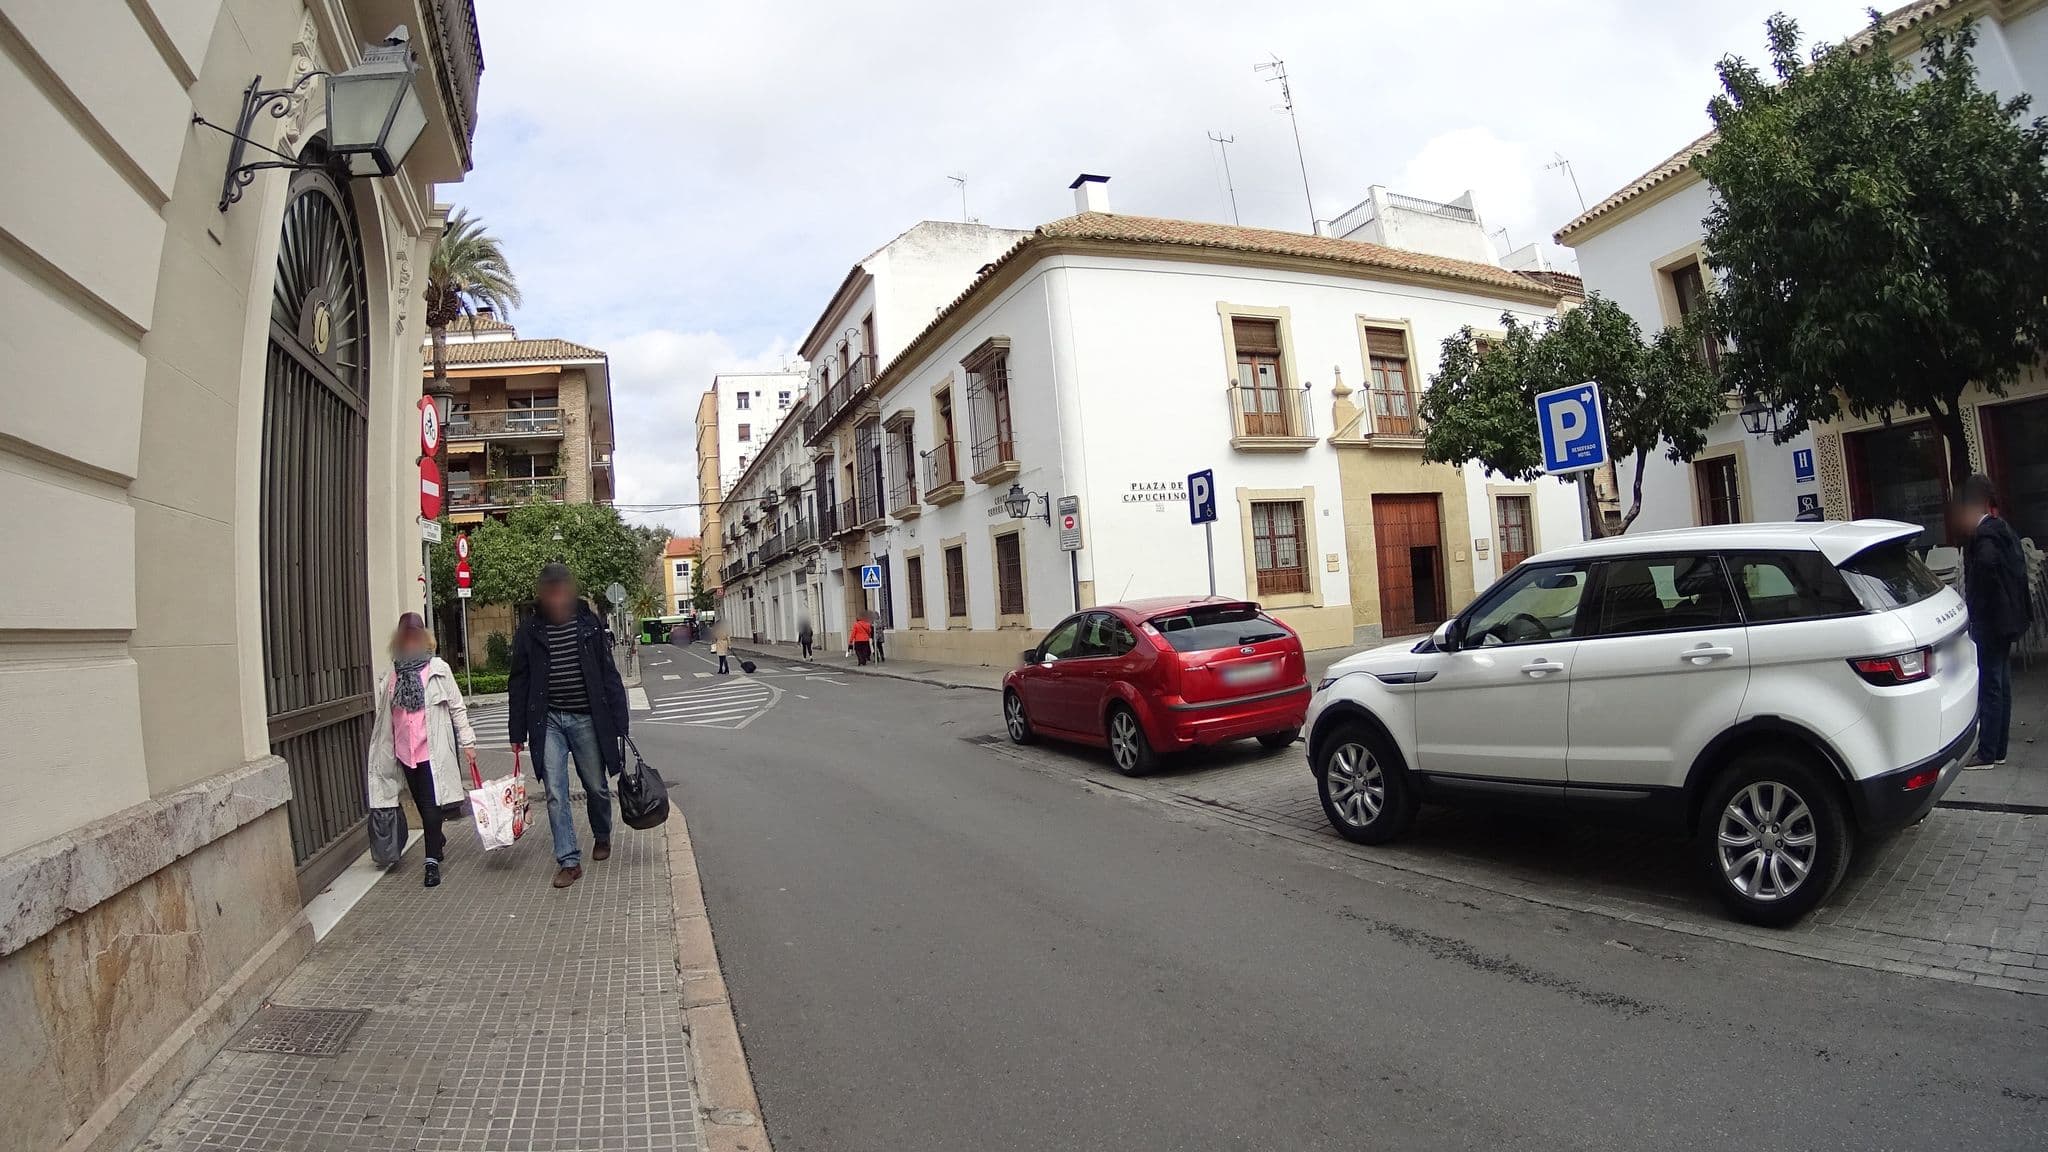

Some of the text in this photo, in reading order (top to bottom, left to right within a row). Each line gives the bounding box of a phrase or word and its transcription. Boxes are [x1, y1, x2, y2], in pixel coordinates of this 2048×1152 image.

[1549, 399, 1587, 463] P
[1123, 492, 1187, 502] CAPUCHINO
[1131, 482, 1184, 490] PLAZA DE
[1192, 476, 1209, 518] P
